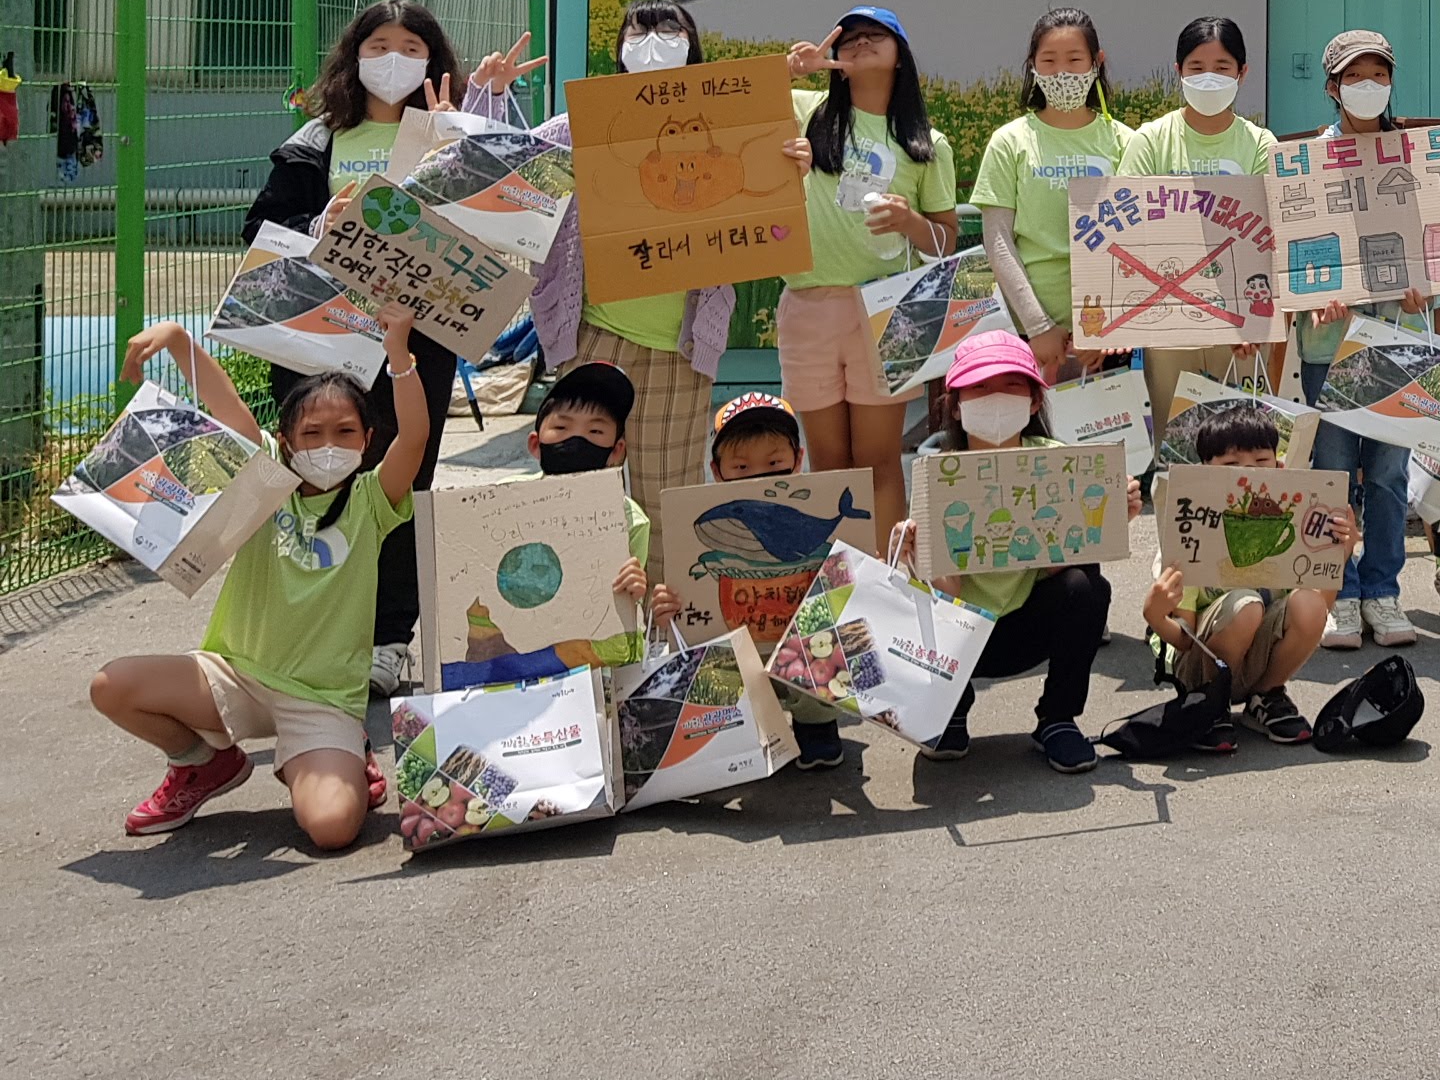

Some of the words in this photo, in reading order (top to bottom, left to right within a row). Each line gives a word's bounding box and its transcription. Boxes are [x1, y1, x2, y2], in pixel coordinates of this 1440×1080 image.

[635, 82, 688, 106] 사용한
[701, 76, 752, 97] 마스크는
[338, 160, 389, 172] NORT
[368, 149, 394, 161] TH
[1055, 155, 1086, 166] THE
[1191, 159, 1219, 170] THE
[1032, 166, 1088, 178] NORTH
[1049, 177, 1069, 190] FA
[1072, 187, 1143, 252] 음식을
[328, 220, 389, 261] 위한
[384, 248, 432, 290] 작은
[408, 221, 508, 294] 지구를
[628, 233, 691, 270] 잘라서
[1094, 410, 1132, 431] 농특산물
[937, 455, 999, 487] 우리
[1016, 454, 1052, 481] 모두
[1175, 497, 1222, 534] 종이컵
[914, 645, 960, 675] 농특산물
[529, 724, 582, 746] 농특산물
